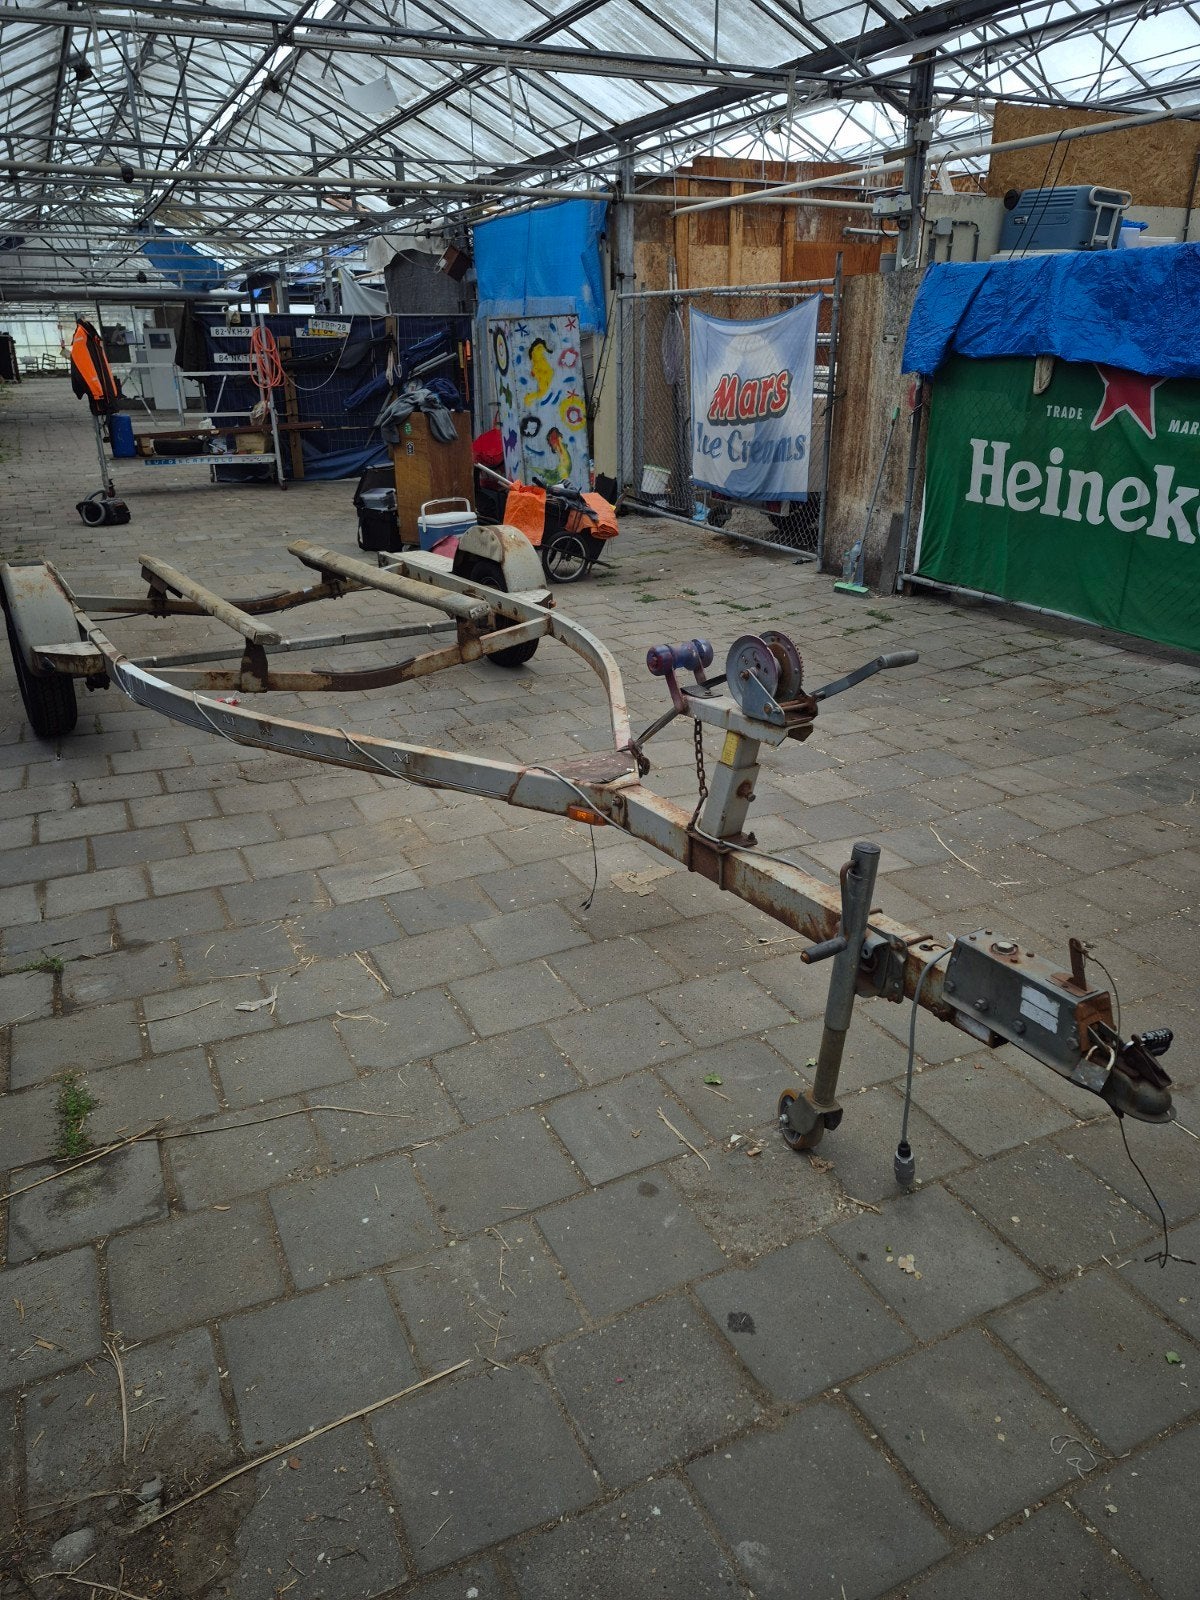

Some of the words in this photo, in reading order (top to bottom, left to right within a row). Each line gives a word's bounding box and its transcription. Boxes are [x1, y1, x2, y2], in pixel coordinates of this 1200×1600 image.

[708, 370, 792, 424] Mars
[1046, 405, 1083, 420] TRADE
[1167, 419, 1200, 436] MAR
[697, 422, 722, 459] Ice
[727, 429, 807, 463] Creams
[965, 438, 1200, 544] Heinek
